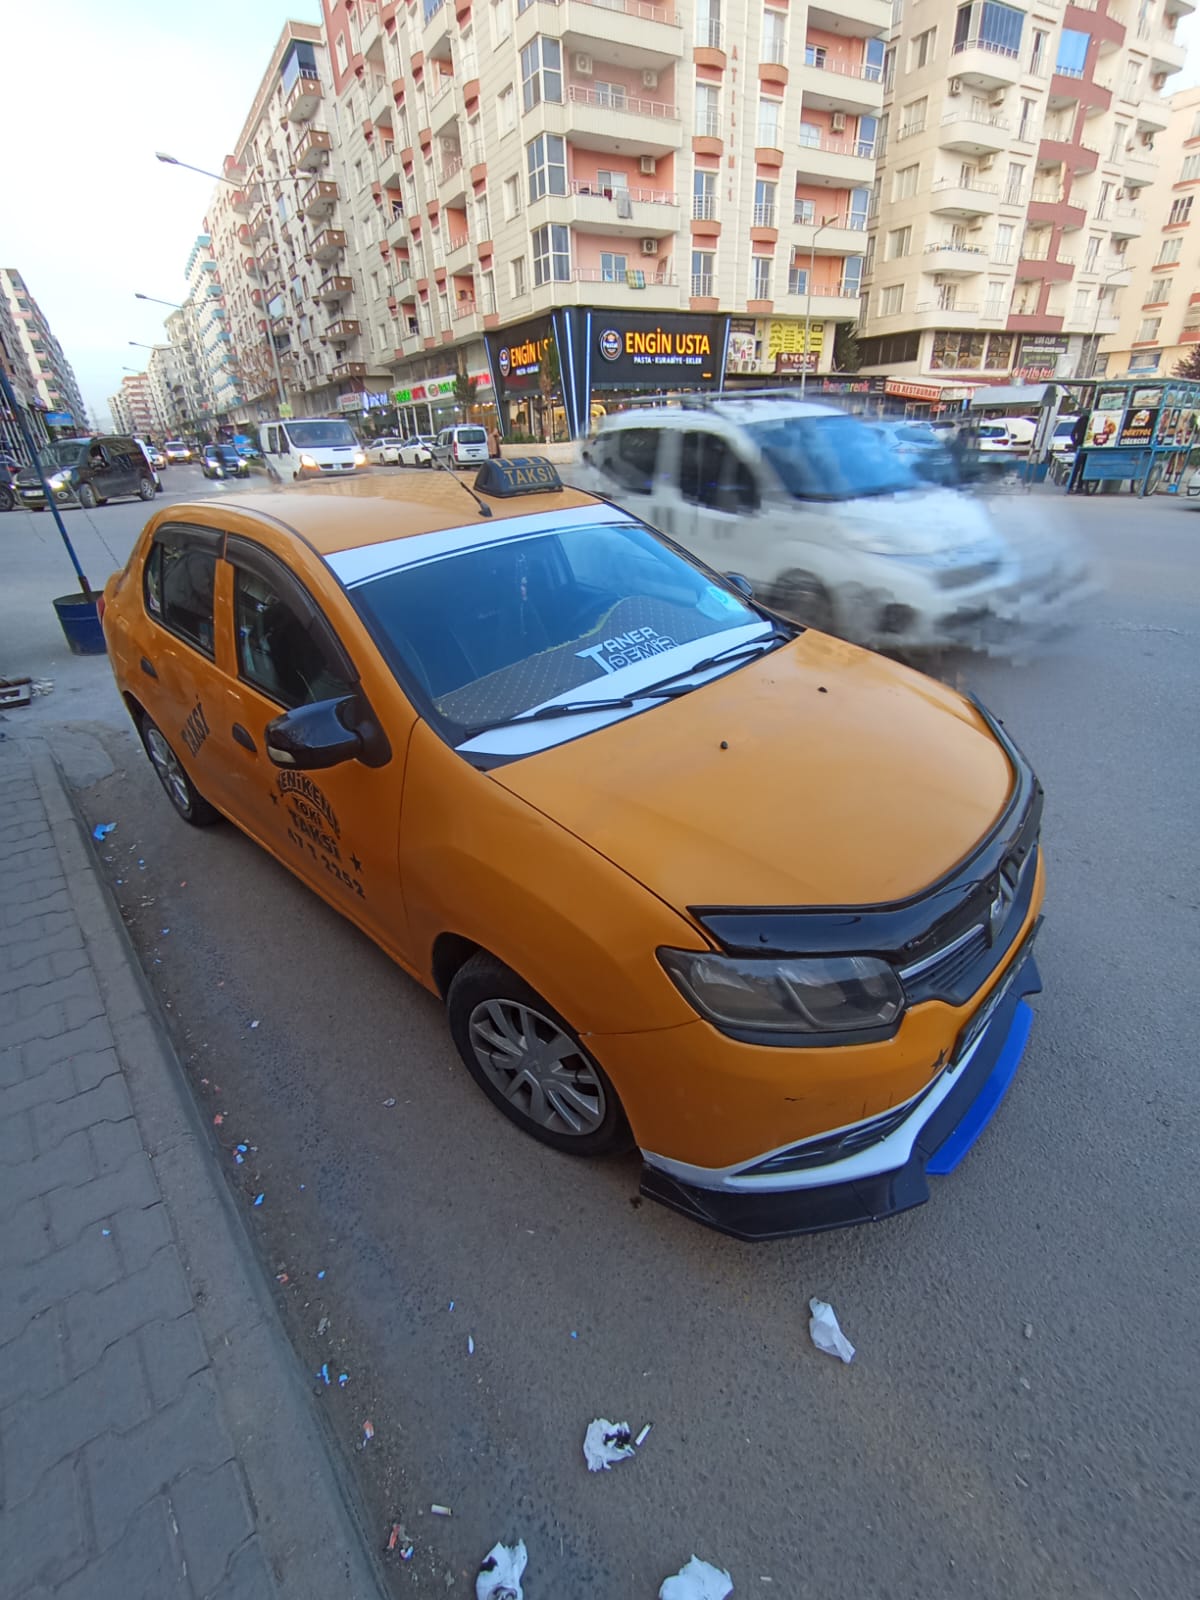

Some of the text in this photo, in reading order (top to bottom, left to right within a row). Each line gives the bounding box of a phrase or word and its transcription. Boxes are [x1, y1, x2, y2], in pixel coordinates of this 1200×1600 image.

[510, 338, 536, 367] ENGİN
[625, 328, 710, 355] ENGİN USTA
[575, 626, 660, 674] TANER
